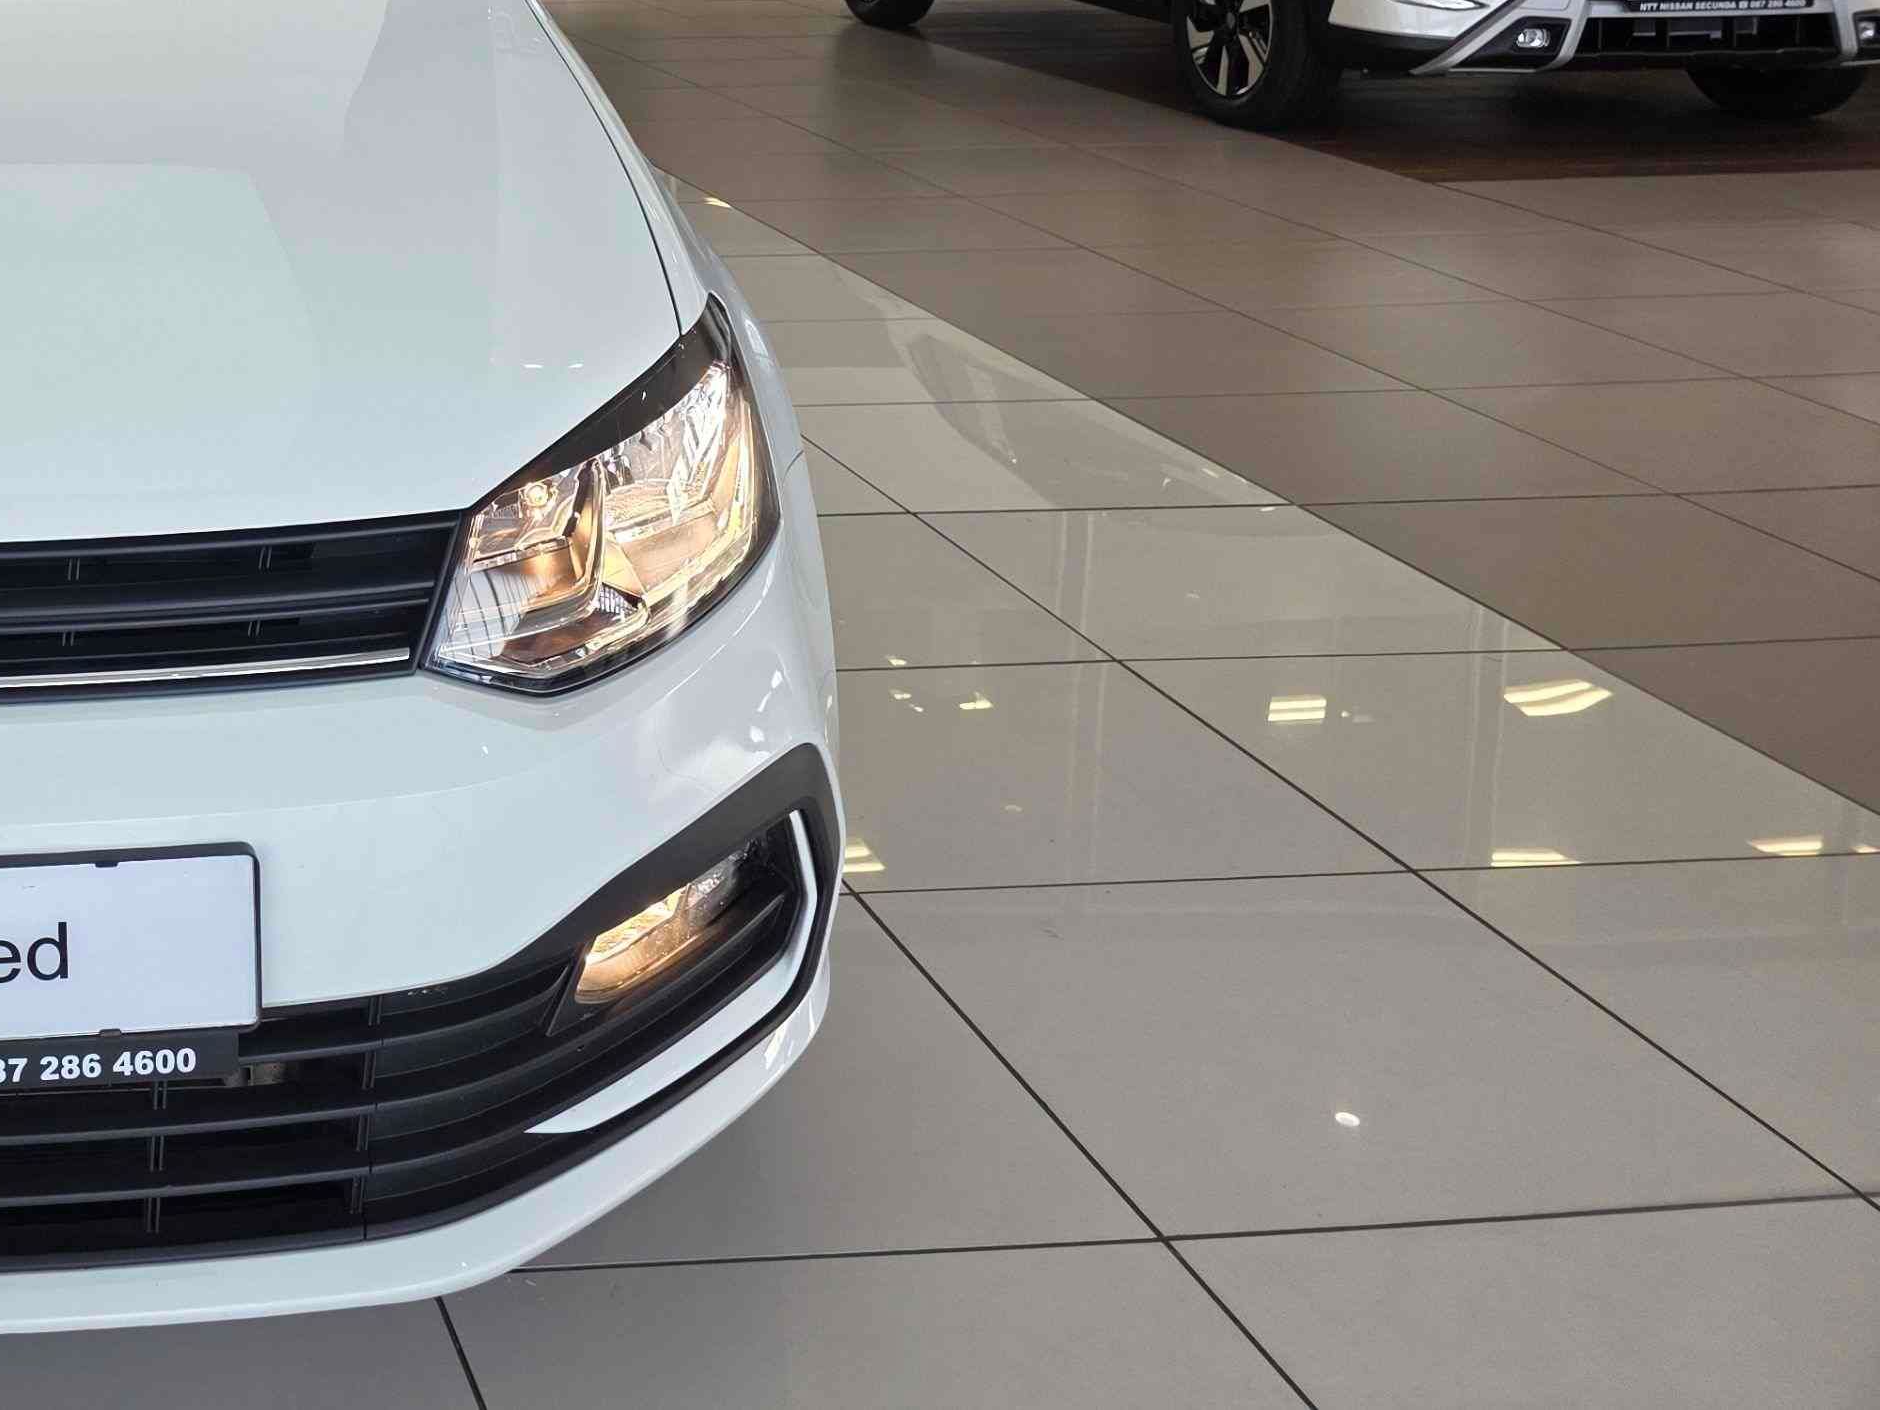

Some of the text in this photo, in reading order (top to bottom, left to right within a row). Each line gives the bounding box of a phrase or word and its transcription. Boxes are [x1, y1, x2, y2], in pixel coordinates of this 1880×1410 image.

[1639, 2, 1659, 11] NTT
[1660, 1, 1694, 11] NISSAN
[1695, 0, 1736, 10] SECUNDA
[40, 1053, 102, 1081] 286
[113, 1047, 197, 1076] 4600
